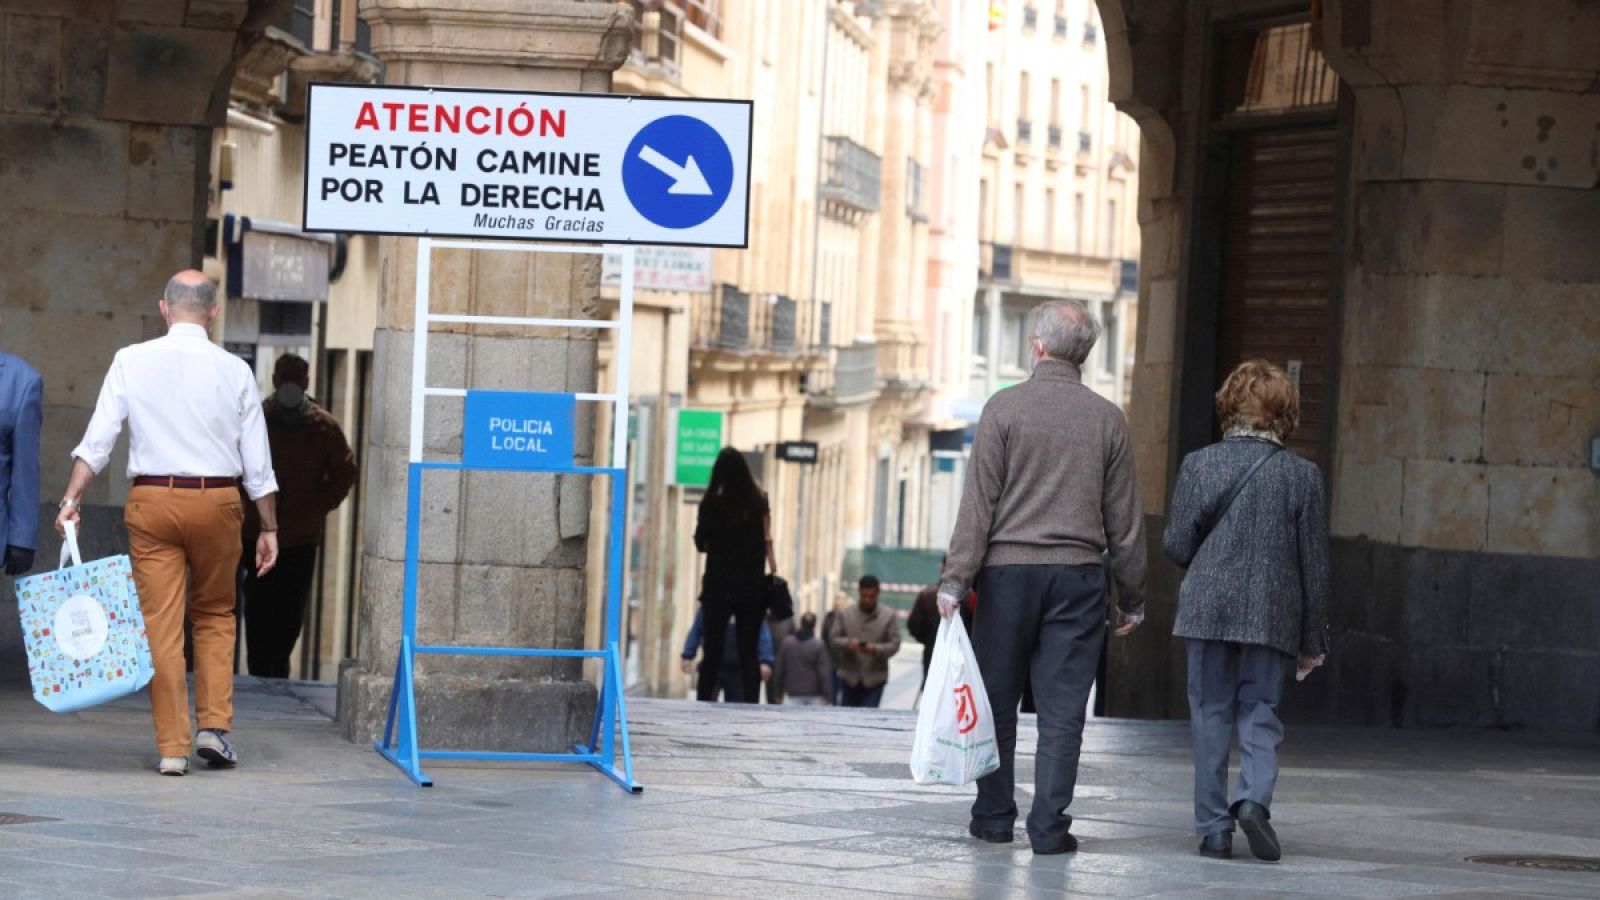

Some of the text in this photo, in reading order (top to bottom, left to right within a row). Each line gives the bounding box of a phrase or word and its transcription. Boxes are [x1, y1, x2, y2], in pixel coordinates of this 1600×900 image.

[354, 101, 567, 138] ATENCIÓN
[328, 142, 601, 177] PEATÓN CAMINE
[320, 177, 605, 212] POR LA DERECHA
[473, 213, 604, 233] Muchas Gracias
[489, 417, 553, 435] POLICIA
[491, 435, 548, 453] LOCAL
